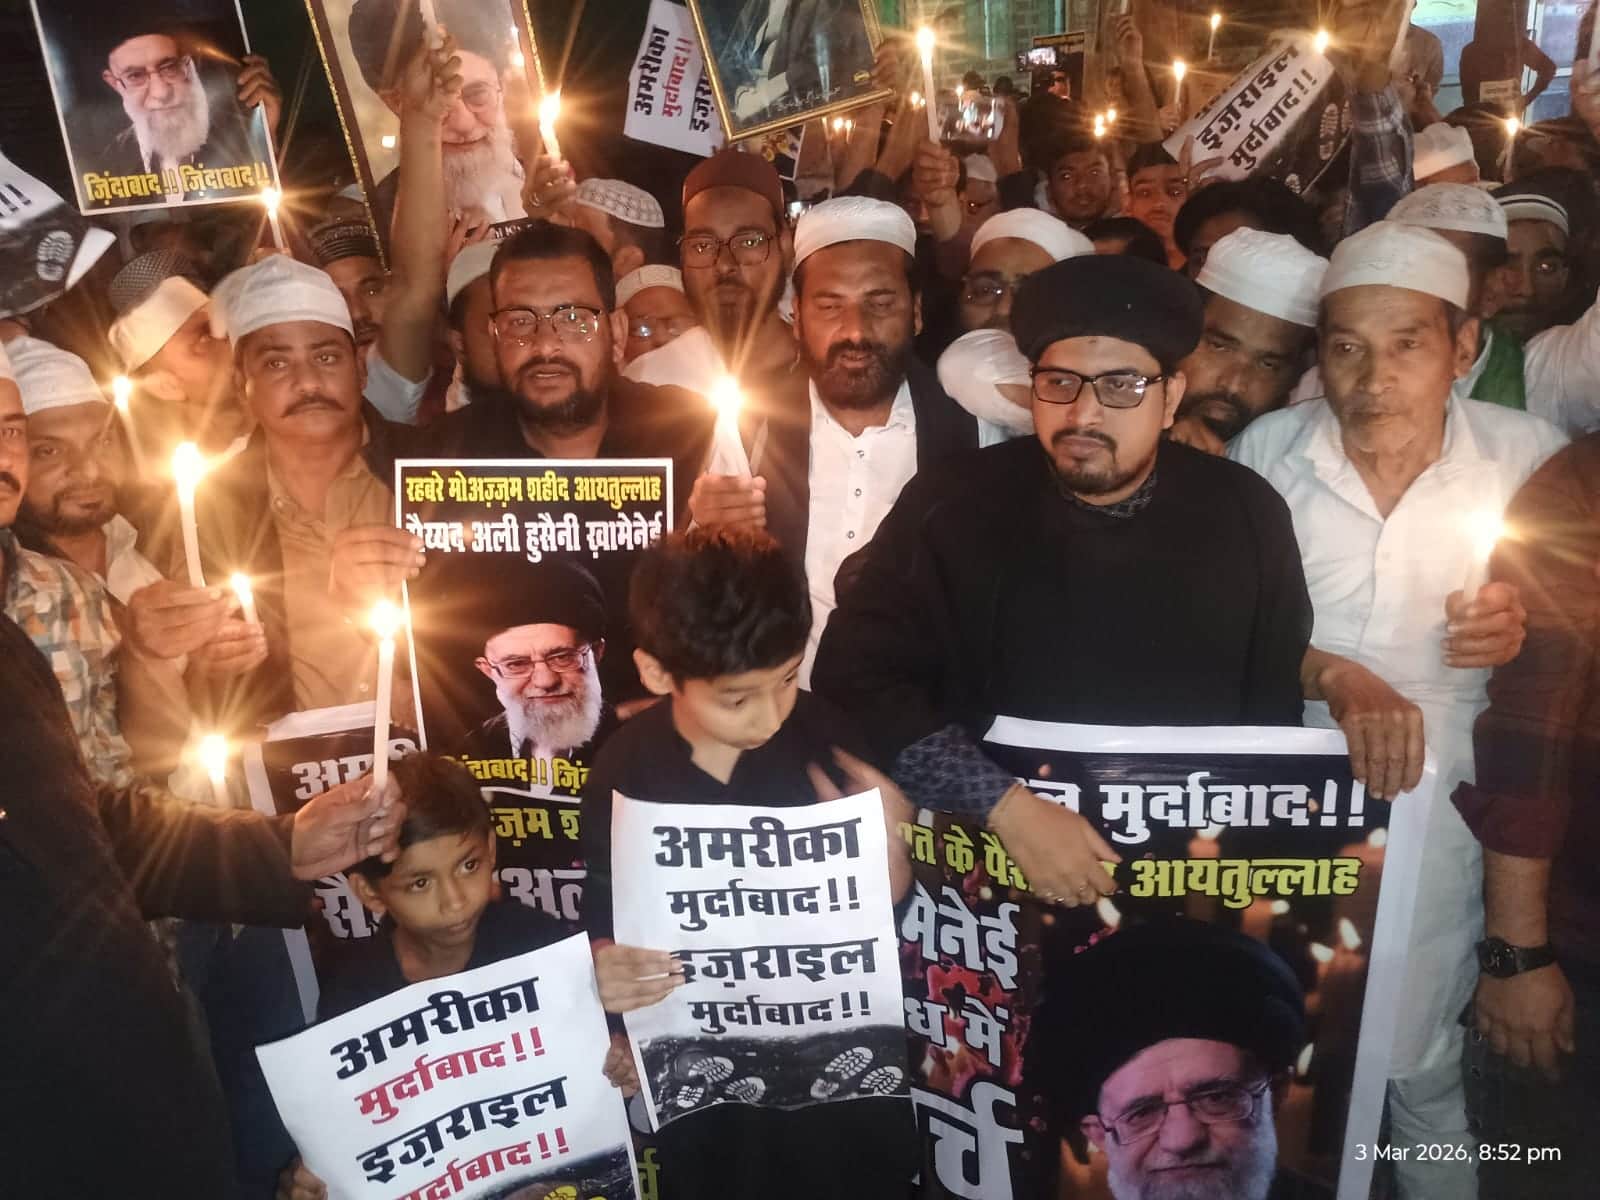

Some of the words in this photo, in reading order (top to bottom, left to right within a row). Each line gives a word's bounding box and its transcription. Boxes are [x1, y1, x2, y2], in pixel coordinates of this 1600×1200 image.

[634, 27, 669, 116] अमरीका
[689, 62, 716, 133] इज़रा
[1228, 69, 1318, 170] मुर्दाबाद!!
[526, 470, 570, 501] शहीद
[574, 474, 661, 510] आयतुल्लाह
[471, 512, 521, 552] अली
[524, 511, 581, 563] हुसैनी
[461, 754, 548, 785] ंदाबाद!!
[653, 816, 861, 868] अमरीका
[1099, 771, 1366, 844] मुर्दाबाद!!
[943, 824, 975, 874] के
[1130, 857, 1362, 909] आयतुल्लाह
[666, 876, 860, 931] मुर्दाबाद!!
[901, 880, 1020, 990] मेनेई
[329, 976, 539, 1080] अमरीका
[688, 991, 871, 1034] मुर्दाबाद!!
[960, 996, 1009, 1067] में
[353, 1026, 545, 1124] मुर्दाबाद!!
[356, 1076, 567, 1184] इज़राइल
[393, 1127, 569, 1200] र्दाबाद!!
